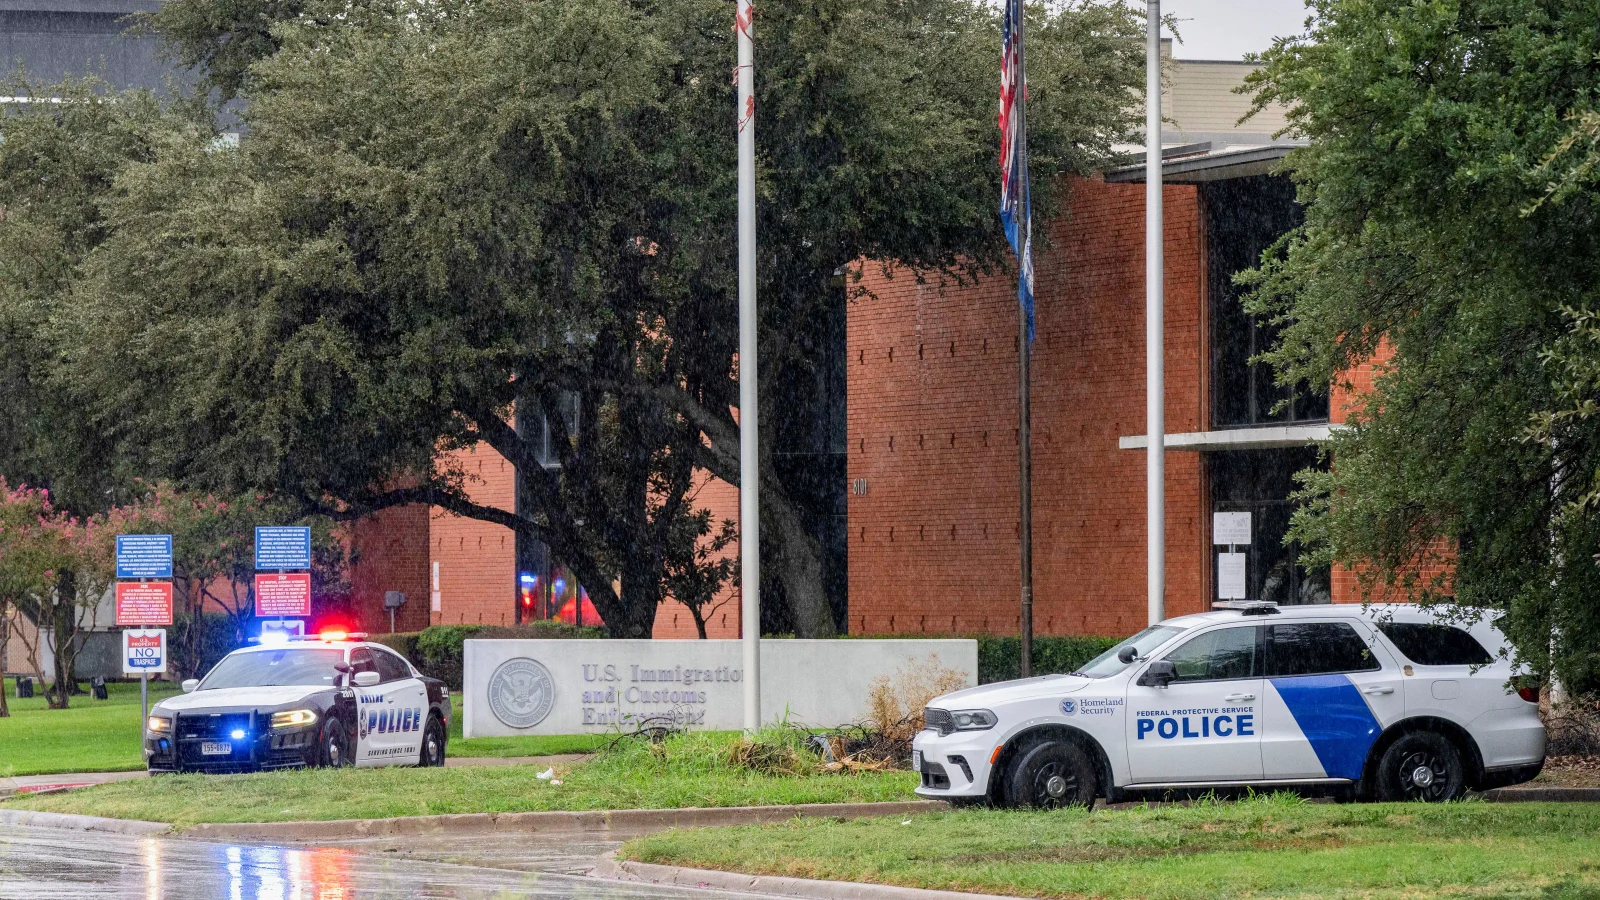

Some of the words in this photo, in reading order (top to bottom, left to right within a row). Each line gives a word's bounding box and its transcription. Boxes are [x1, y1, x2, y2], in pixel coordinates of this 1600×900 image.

[135, 647, 154, 658] NO
[582, 664, 622, 682] U.S.
[360, 694, 384, 704] DALLAS
[582, 686, 616, 703] and
[624, 686, 707, 704] Customs
[1080, 697, 1123, 707] Homeland
[1080, 706, 1115, 716] Security
[1172, 708, 1219, 716] PROTECTIVE
[1221, 706, 1254, 714] SERVICE
[367, 708, 421, 735] POLICE
[1137, 714, 1255, 740] POLICE
[368, 748, 388, 757] SERVING
[389, 747, 403, 755] SINCE
